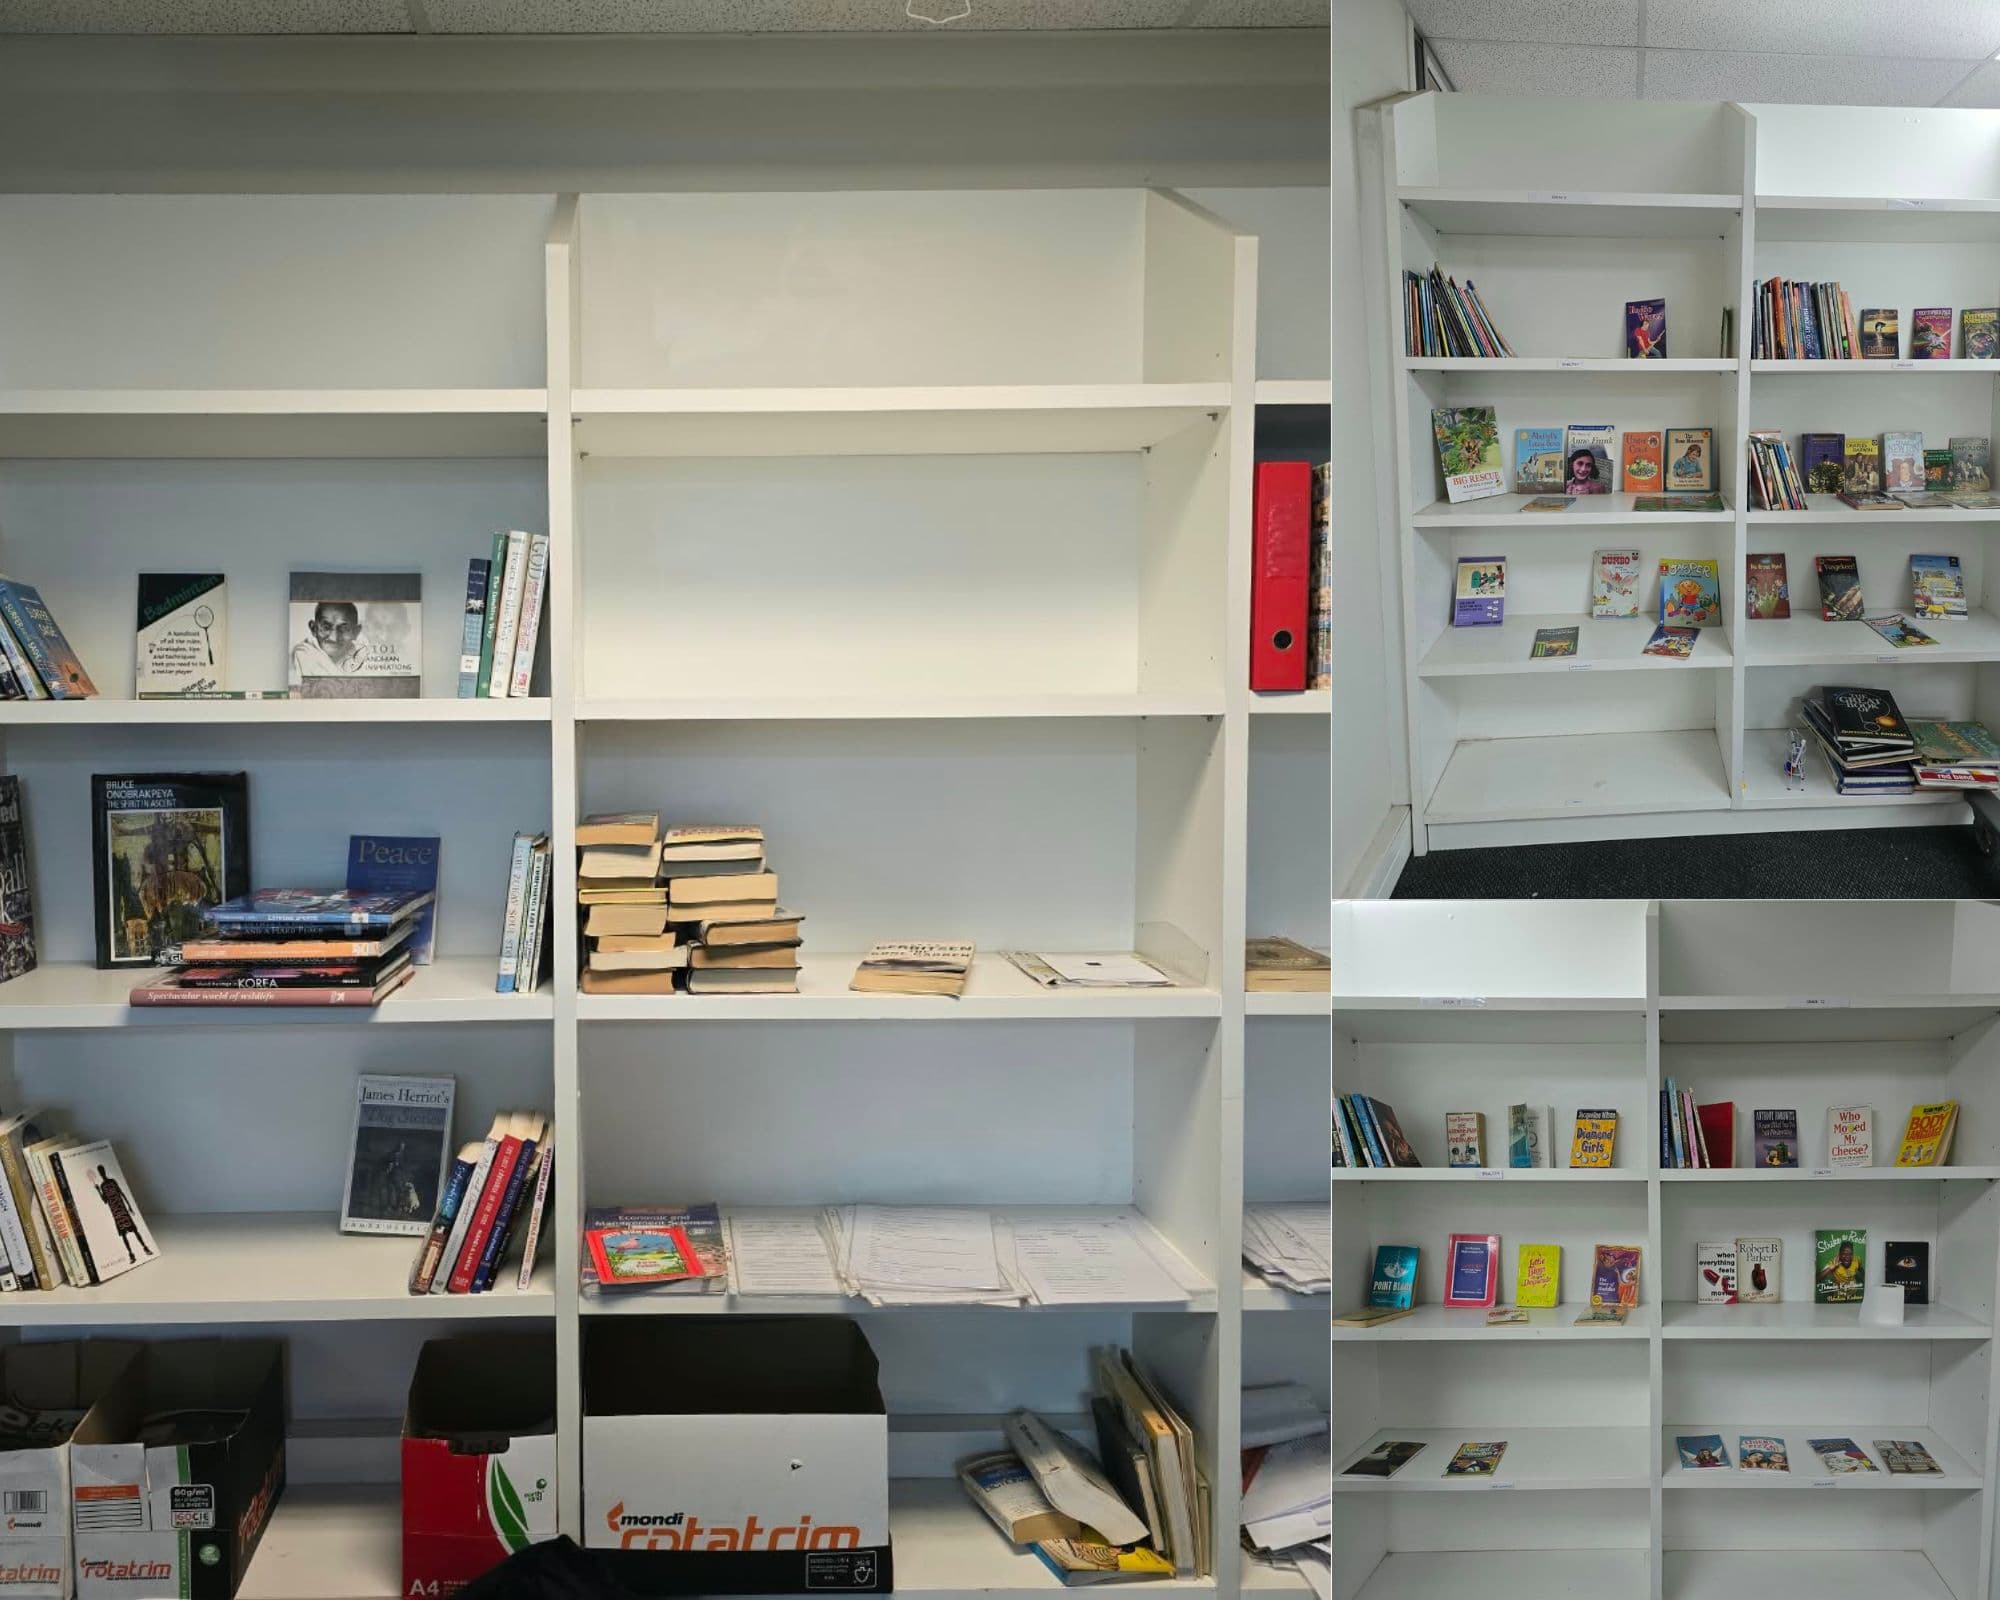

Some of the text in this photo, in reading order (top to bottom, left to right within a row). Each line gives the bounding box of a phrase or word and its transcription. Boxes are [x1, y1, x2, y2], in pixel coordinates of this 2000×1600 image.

[1570, 436, 1589, 444] Anne
[1591, 435, 1613, 444] Frank
[1453, 471, 1499, 486] BIG RESCUE
[1601, 556, 1630, 565] DUMBO
[144, 575, 220, 622] Badminton
[106, 780, 134, 790] BRUCE
[106, 788, 174, 800] ONOBRAKPEYA
[358, 839, 433, 866] Peace
[238, 978, 278, 989] KOREA
[148, 991, 200, 1002] Spectacular
[202, 990, 228, 1000] world
[230, 991, 240, 1001] of
[360, 1087, 449, 1104] James Herriot's
[1839, 1111, 1861, 1121] Who
[1910, 1113, 1946, 1131] BODY
[1577, 1128, 1614, 1139] Diamond
[1844, 1134, 1857, 1144] My
[1581, 1140, 1605, 1153] Girls
[1831, 1143, 1869, 1157] Cheese?
[1740, 1243, 1770, 1253] Robert
[1699, 1259, 1735, 1267] everything
[1746, 1252, 1773, 1262] Parker
[1373, 1280, 1392, 1291] POINT
[620, 1512, 684, 1527] mondi
[620, 1515, 862, 1551] rotatrim
[0, 1563, 61, 1582] tatrim
[84, 1560, 172, 1579] rotatrim
[409, 1579, 439, 1596] A4
